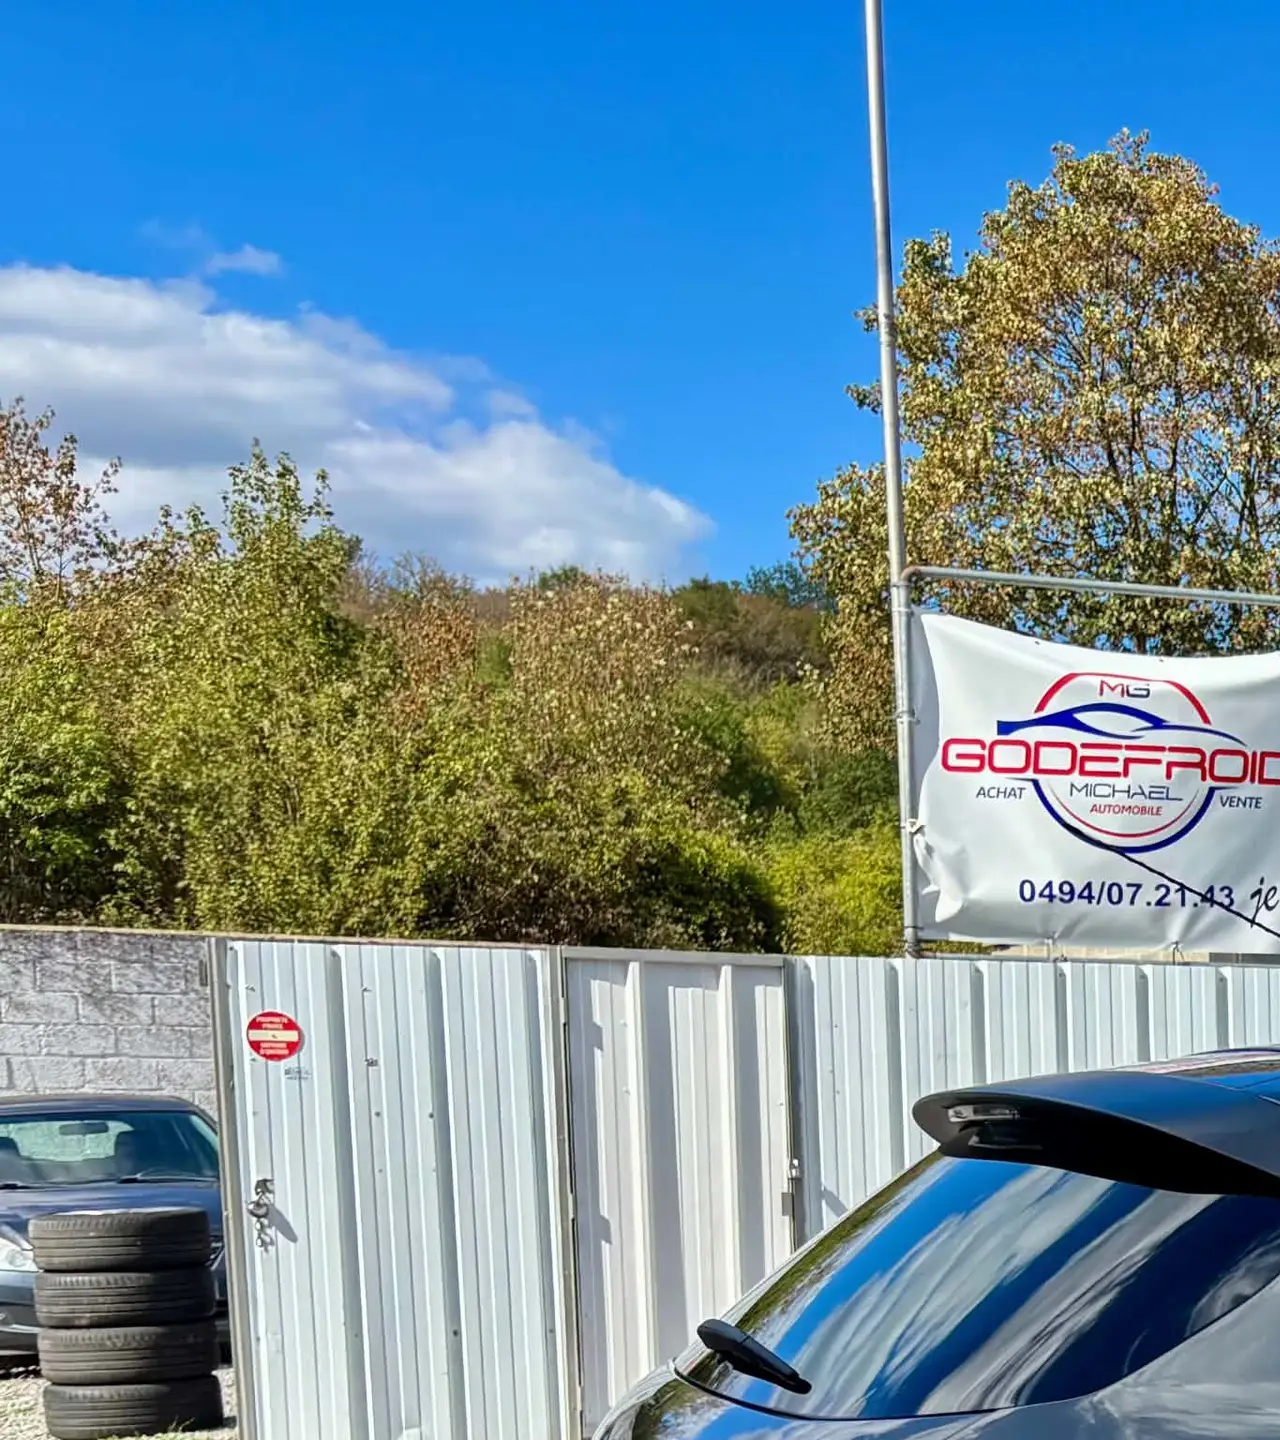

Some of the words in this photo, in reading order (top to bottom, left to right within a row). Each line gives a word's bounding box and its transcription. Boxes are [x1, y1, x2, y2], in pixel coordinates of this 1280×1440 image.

[1098, 680, 1151, 698] MG
[975, 786, 1027, 800] ACHAT
[1069, 782, 1184, 801] MICHAEL
[1090, 804, 1163, 816] AUTOMOBILE
[1219, 795, 1263, 810] VENTE
[1019, 879, 1235, 908] 0494/07.21.43
[1250, 877, 1280, 928] je
